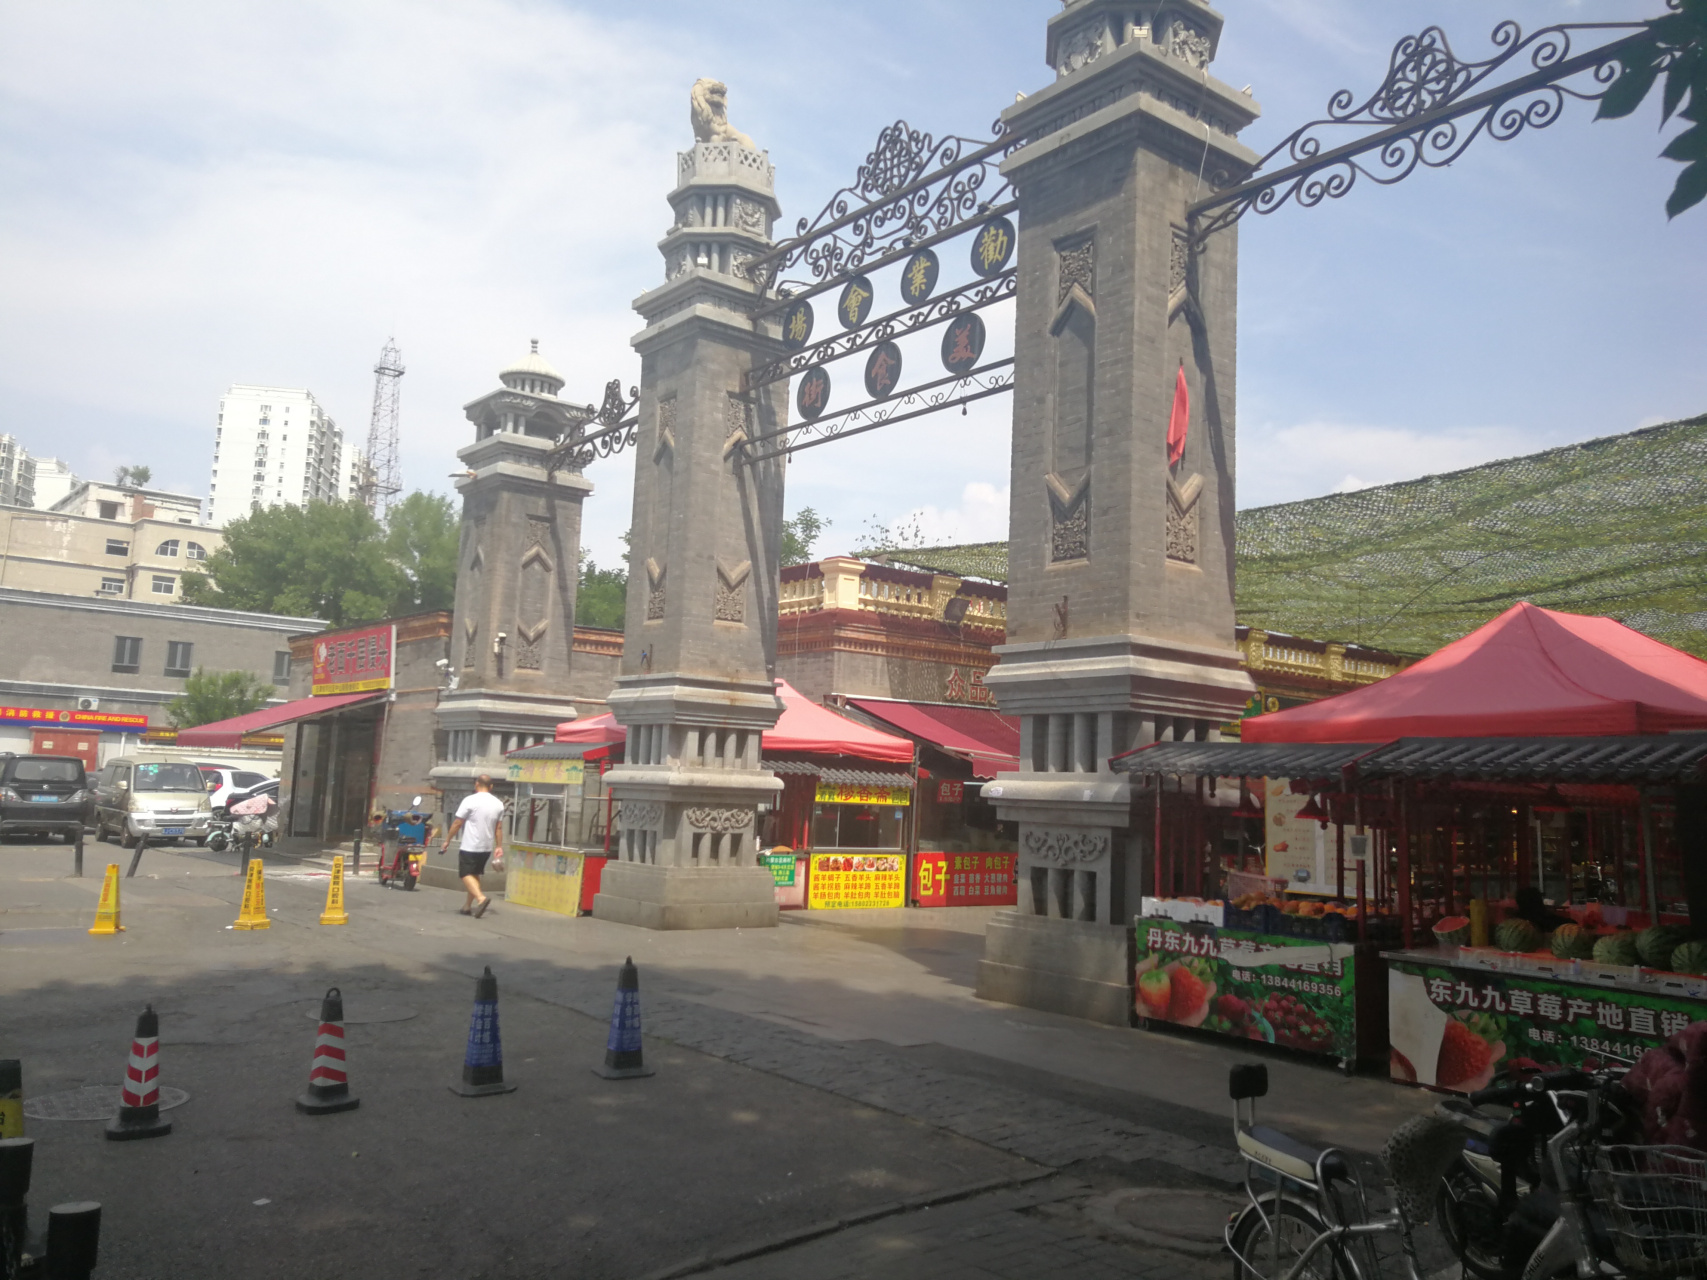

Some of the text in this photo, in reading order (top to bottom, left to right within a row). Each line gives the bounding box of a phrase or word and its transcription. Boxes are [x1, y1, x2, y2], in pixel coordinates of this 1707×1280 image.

[945, 668, 995, 703] 众品
[0, 708, 55, 720] 消防救援
[121, 716, 145, 724] RESCUE
[941, 782, 962, 796] 包子
[954, 856, 1010, 870] 素包子 肉包子
[844, 873, 871, 882] 五香羊头
[874, 873, 900, 882] 麻辣羊头
[919, 860, 950, 895] 包子
